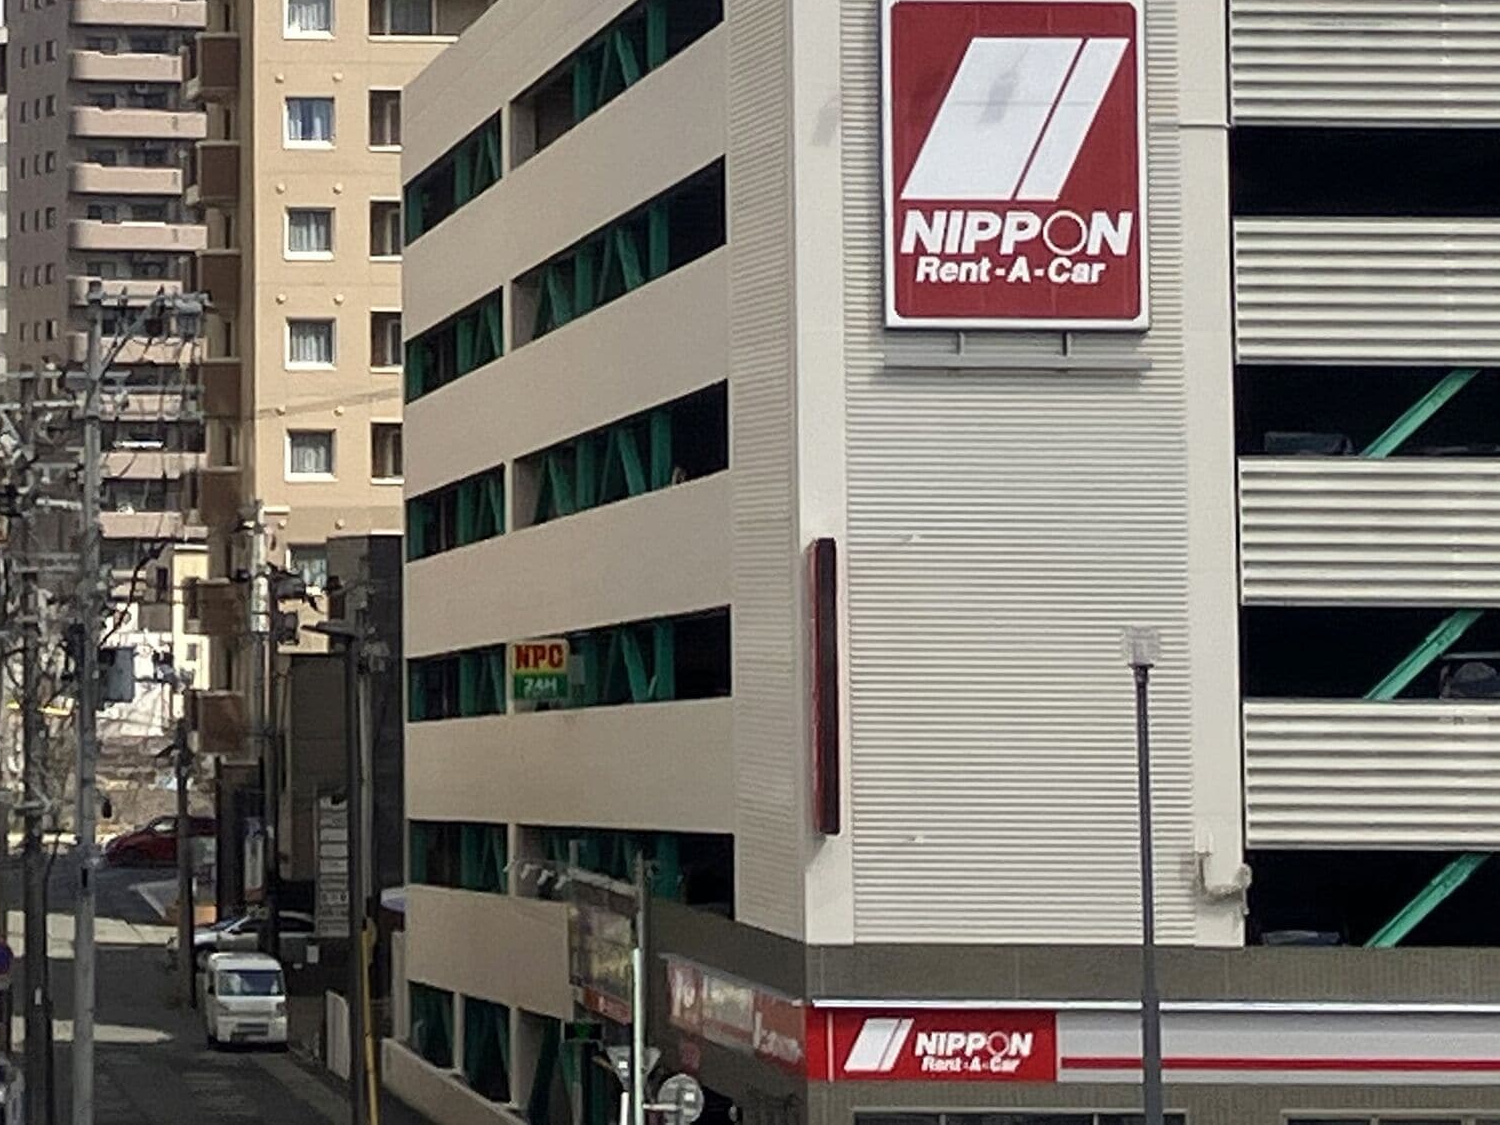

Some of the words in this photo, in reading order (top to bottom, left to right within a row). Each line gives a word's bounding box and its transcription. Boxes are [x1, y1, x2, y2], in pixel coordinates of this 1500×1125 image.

[900, 209, 1133, 256] NIPPON
[513, 643, 564, 670] NPC
[915, 1031, 1033, 1057] NIPPON
